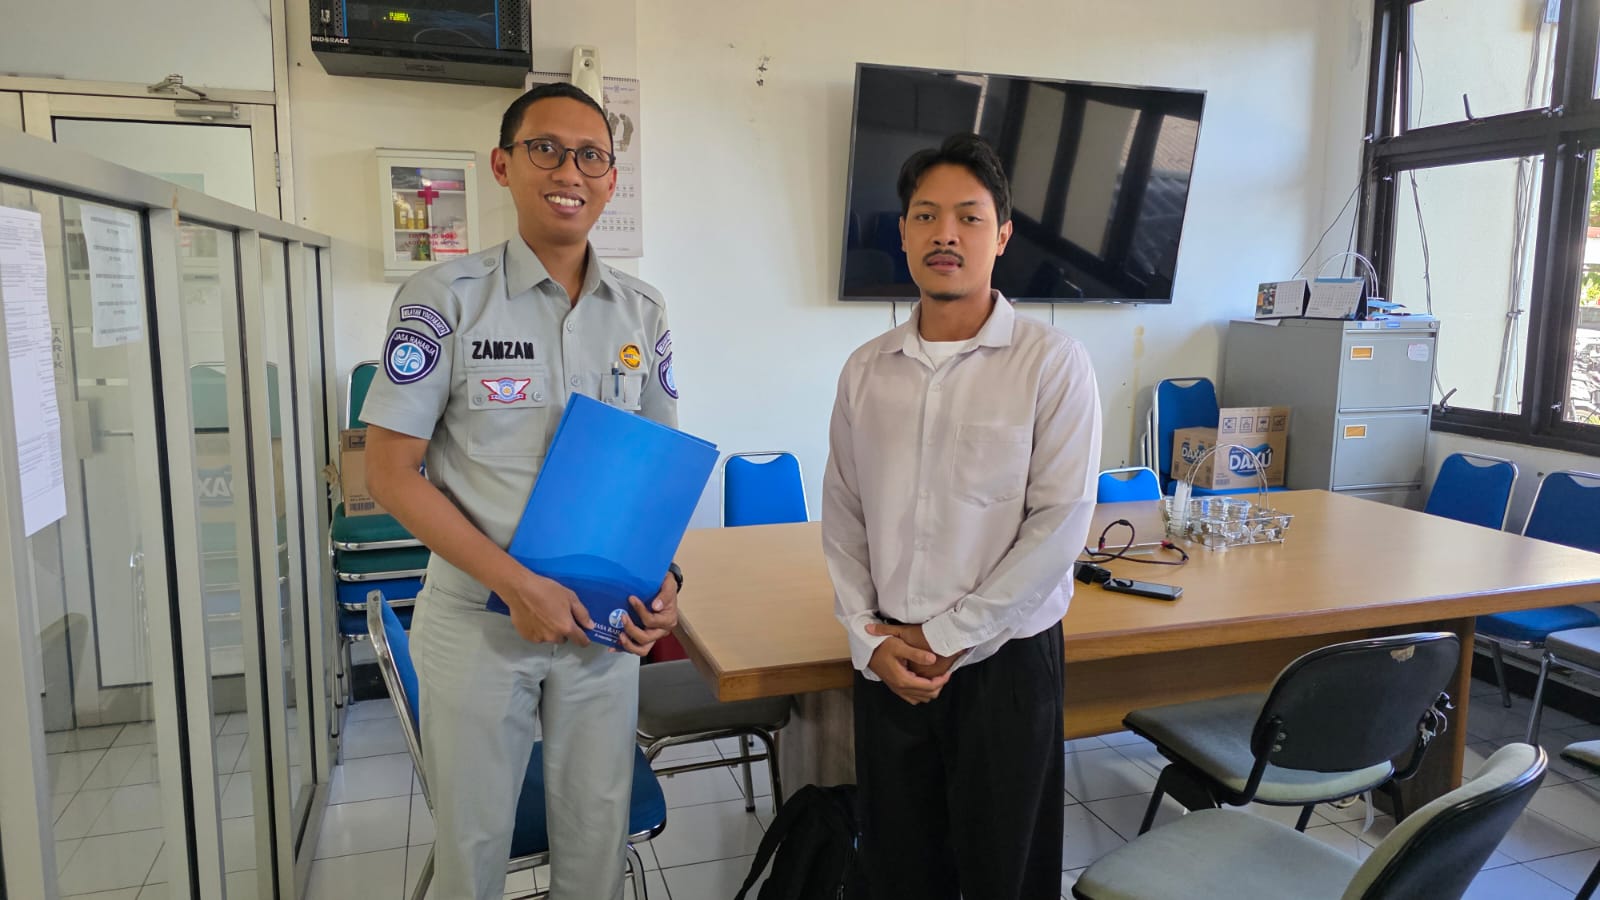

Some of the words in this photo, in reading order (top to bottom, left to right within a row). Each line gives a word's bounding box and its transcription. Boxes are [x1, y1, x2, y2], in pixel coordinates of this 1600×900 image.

[52, 327, 64, 369] TARIK
[394, 333, 409, 341] JASA
[409, 335, 437, 357] RAHARJA
[471, 339, 534, 360] ZAMZAM
